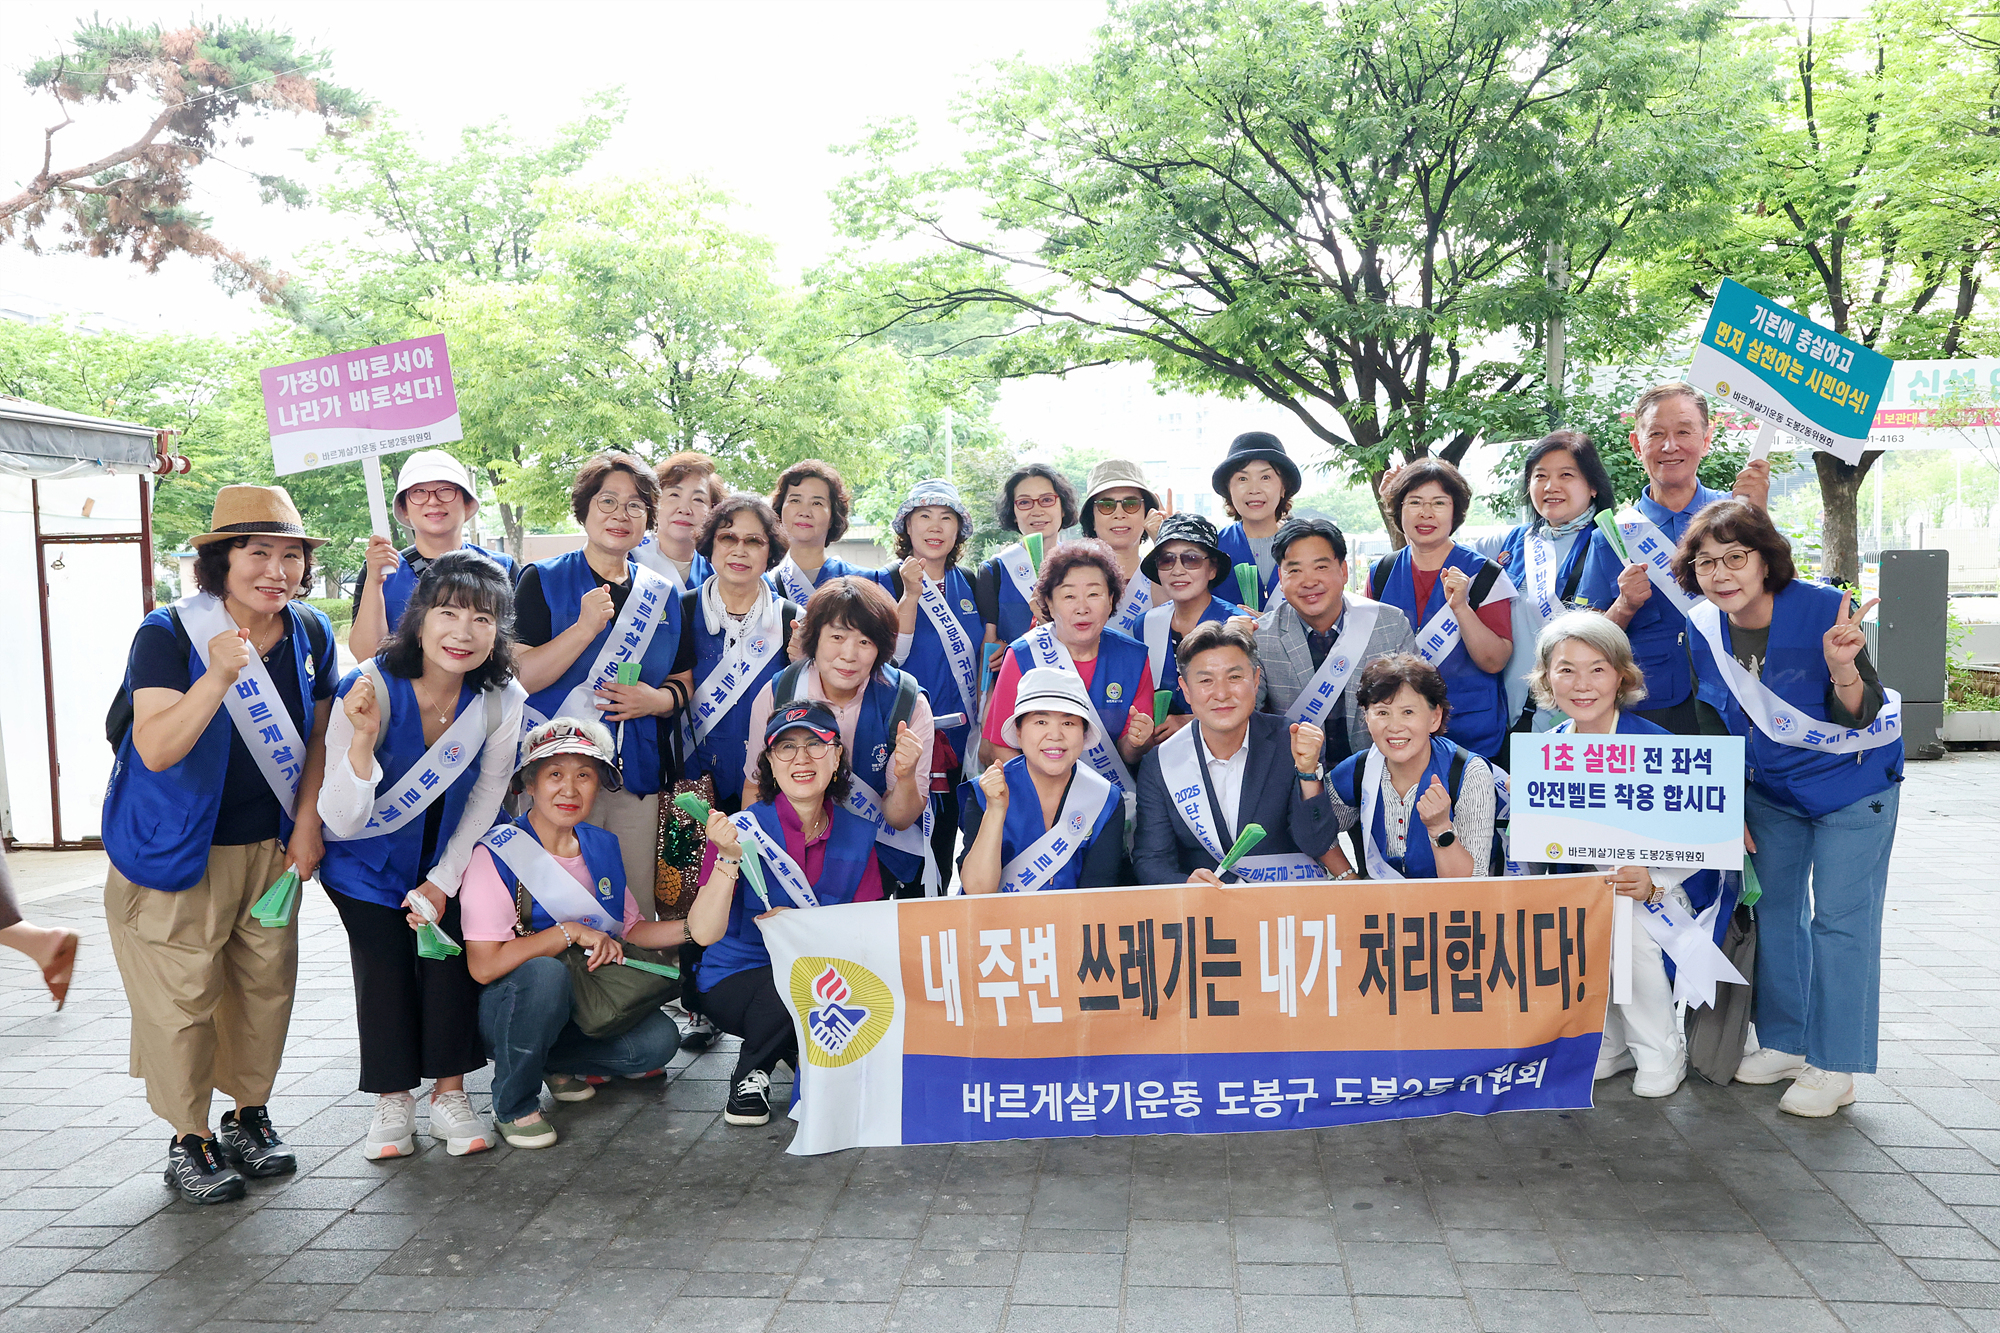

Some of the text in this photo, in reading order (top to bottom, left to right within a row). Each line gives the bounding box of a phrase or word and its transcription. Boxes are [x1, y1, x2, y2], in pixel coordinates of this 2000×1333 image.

[1750, 304, 1855, 374] 기본에 충실하고
[276, 346, 434, 397] 가정이 바로서야
[1713, 321, 1744, 355] 먼저
[1747, 339, 1804, 385] 실천하는
[1805, 367, 1871, 416] 시민의식!
[278, 375, 443, 427] 나라가 바로선다!
[1732, 389, 1834, 448] 바르게살기운동 도봉2동위원회
[321, 431, 432, 461] 바르게살기운동 도봉2동위원회
[1541, 743, 1712, 775] 1초 실천! 전 좌석
[1174, 784, 1201, 804] 2025
[1527, 781, 1606, 810] 안전벨트
[1614, 783, 1655, 811] 착용
[1663, 784, 1726, 813] 합시다
[1568, 846, 1705, 862] 바르게살기운동 도봉2동위원회
[920, 906, 1587, 1026] 내 주변 쓰레기는 내가 처리합시다!
[962, 1080, 1203, 1122] 바르게살기운동
[1216, 1078, 1320, 1118] 도봉구
